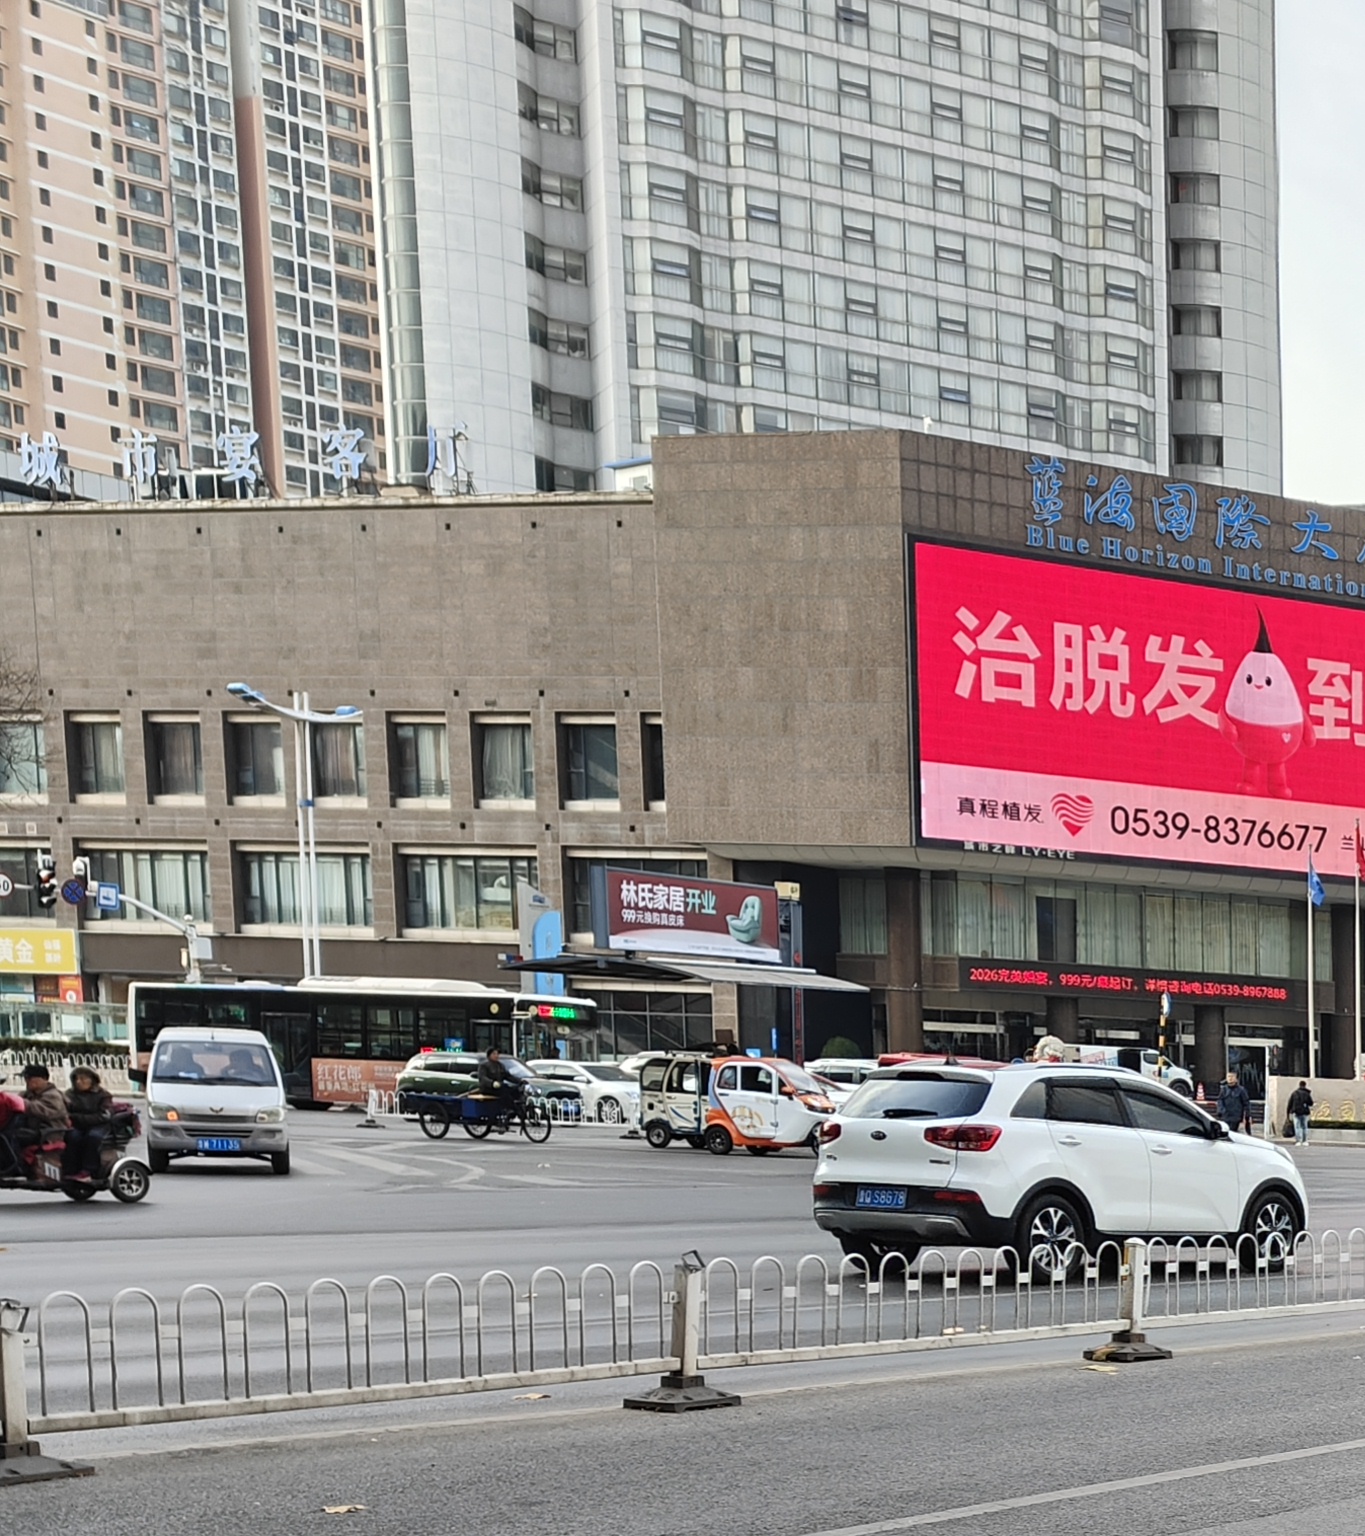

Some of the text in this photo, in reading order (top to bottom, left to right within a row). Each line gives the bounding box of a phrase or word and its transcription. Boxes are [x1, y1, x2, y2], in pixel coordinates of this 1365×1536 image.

[1026, 523, 1090, 555] Blue
[1100, 536, 1212, 575] Horizon
[952, 606, 1224, 730] 治脱发
[957, 796, 1043, 823] 真程植发
[1110, 805, 1328, 853] 0539-8376677
[621, 879, 717, 915] 林氏家居开业
